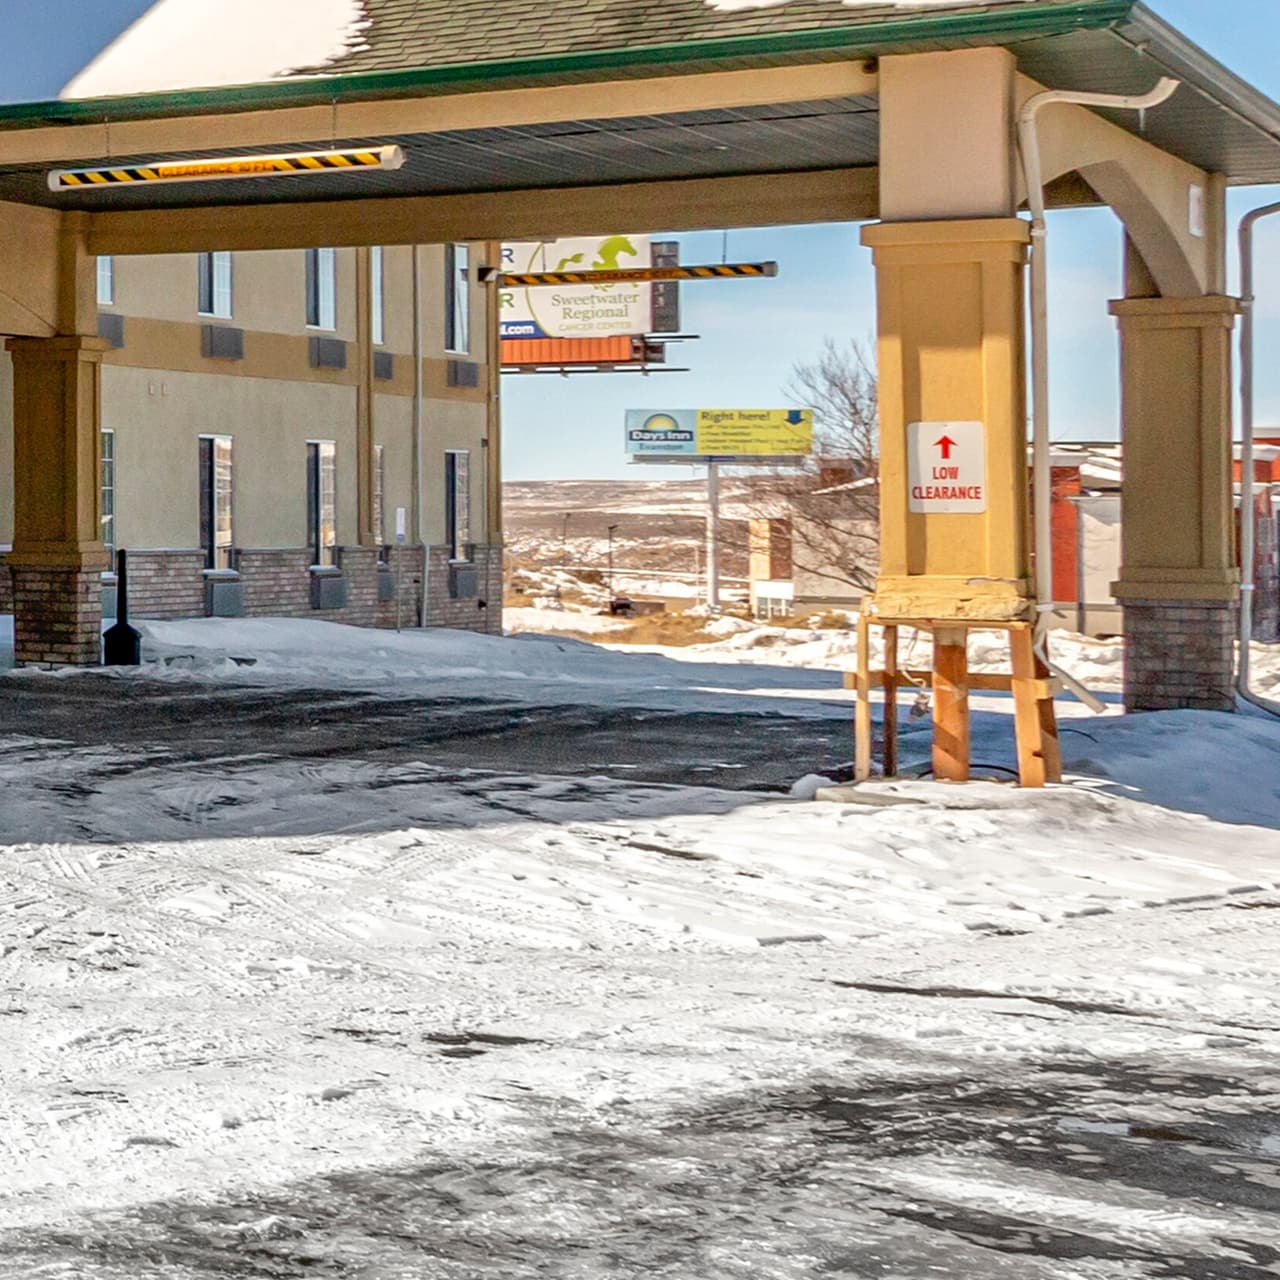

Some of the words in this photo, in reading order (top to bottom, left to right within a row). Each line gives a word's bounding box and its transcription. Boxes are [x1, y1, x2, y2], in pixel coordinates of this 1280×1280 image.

[161, 163, 233, 177] CLEARANCE
[551, 293, 640, 307] Sweetwater
[562, 304, 629, 321] Regional
[701, 411, 734, 423] Right
[738, 410, 770, 421] here!
[631, 431, 665, 441] Days
[666, 431, 691, 440] Inn
[932, 466, 959, 480] LOW
[911, 486, 982, 500] CLEARANCE
